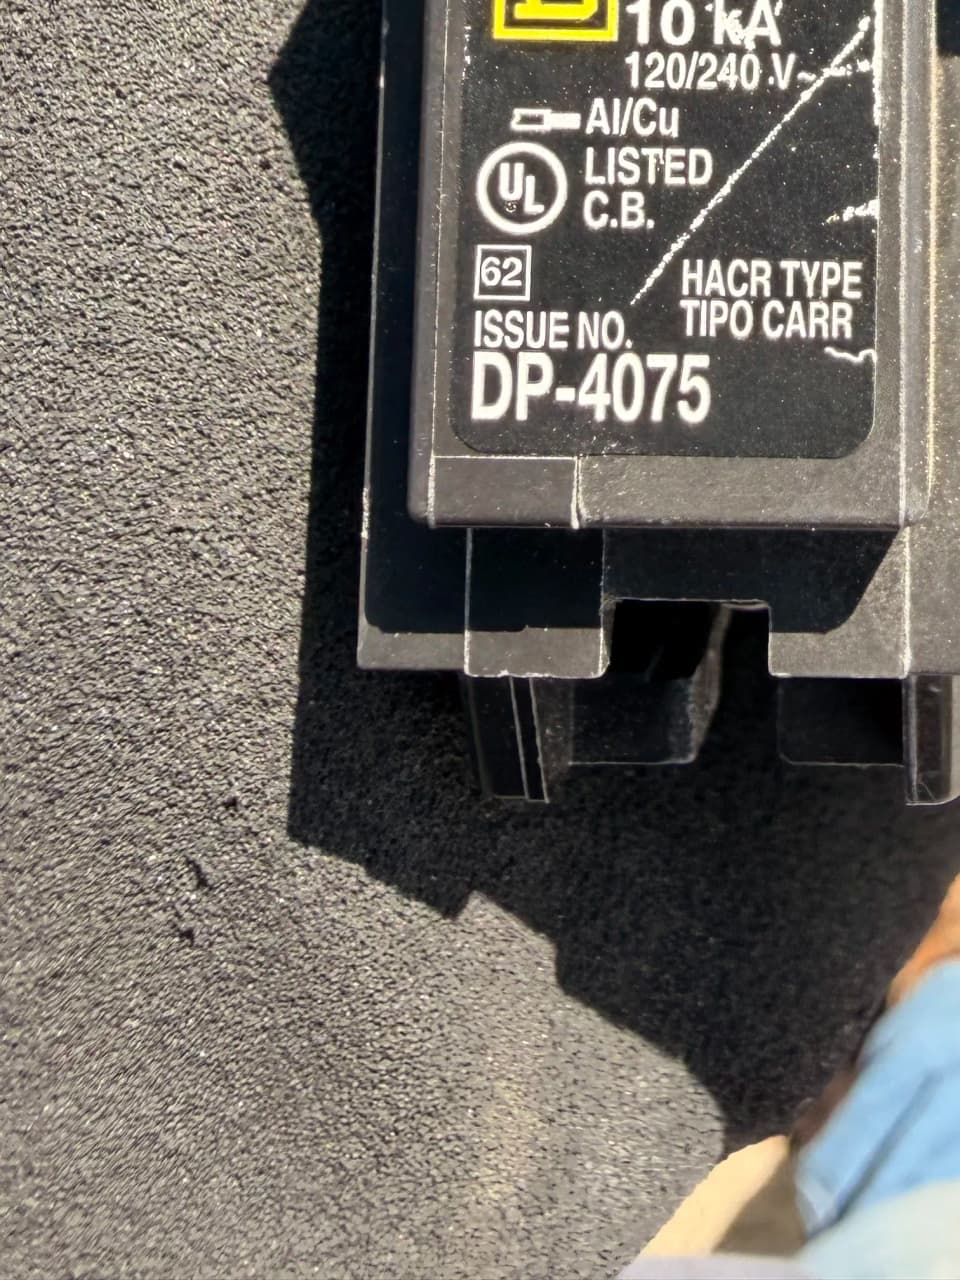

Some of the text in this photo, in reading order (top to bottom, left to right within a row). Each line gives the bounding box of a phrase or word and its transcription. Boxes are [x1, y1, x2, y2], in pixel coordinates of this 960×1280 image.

[625, 51, 761, 91] 120/240
[498, 146, 714, 215] UL LISTED
[583, 190, 656, 231] C.B.
[480, 256, 523, 287] 62
[681, 258, 864, 300] HACR TYPE
[473, 308, 634, 351] ISSUE NO.
[680, 299, 854, 340] TIPO CARR
[470, 349, 712, 425] DP-4075
